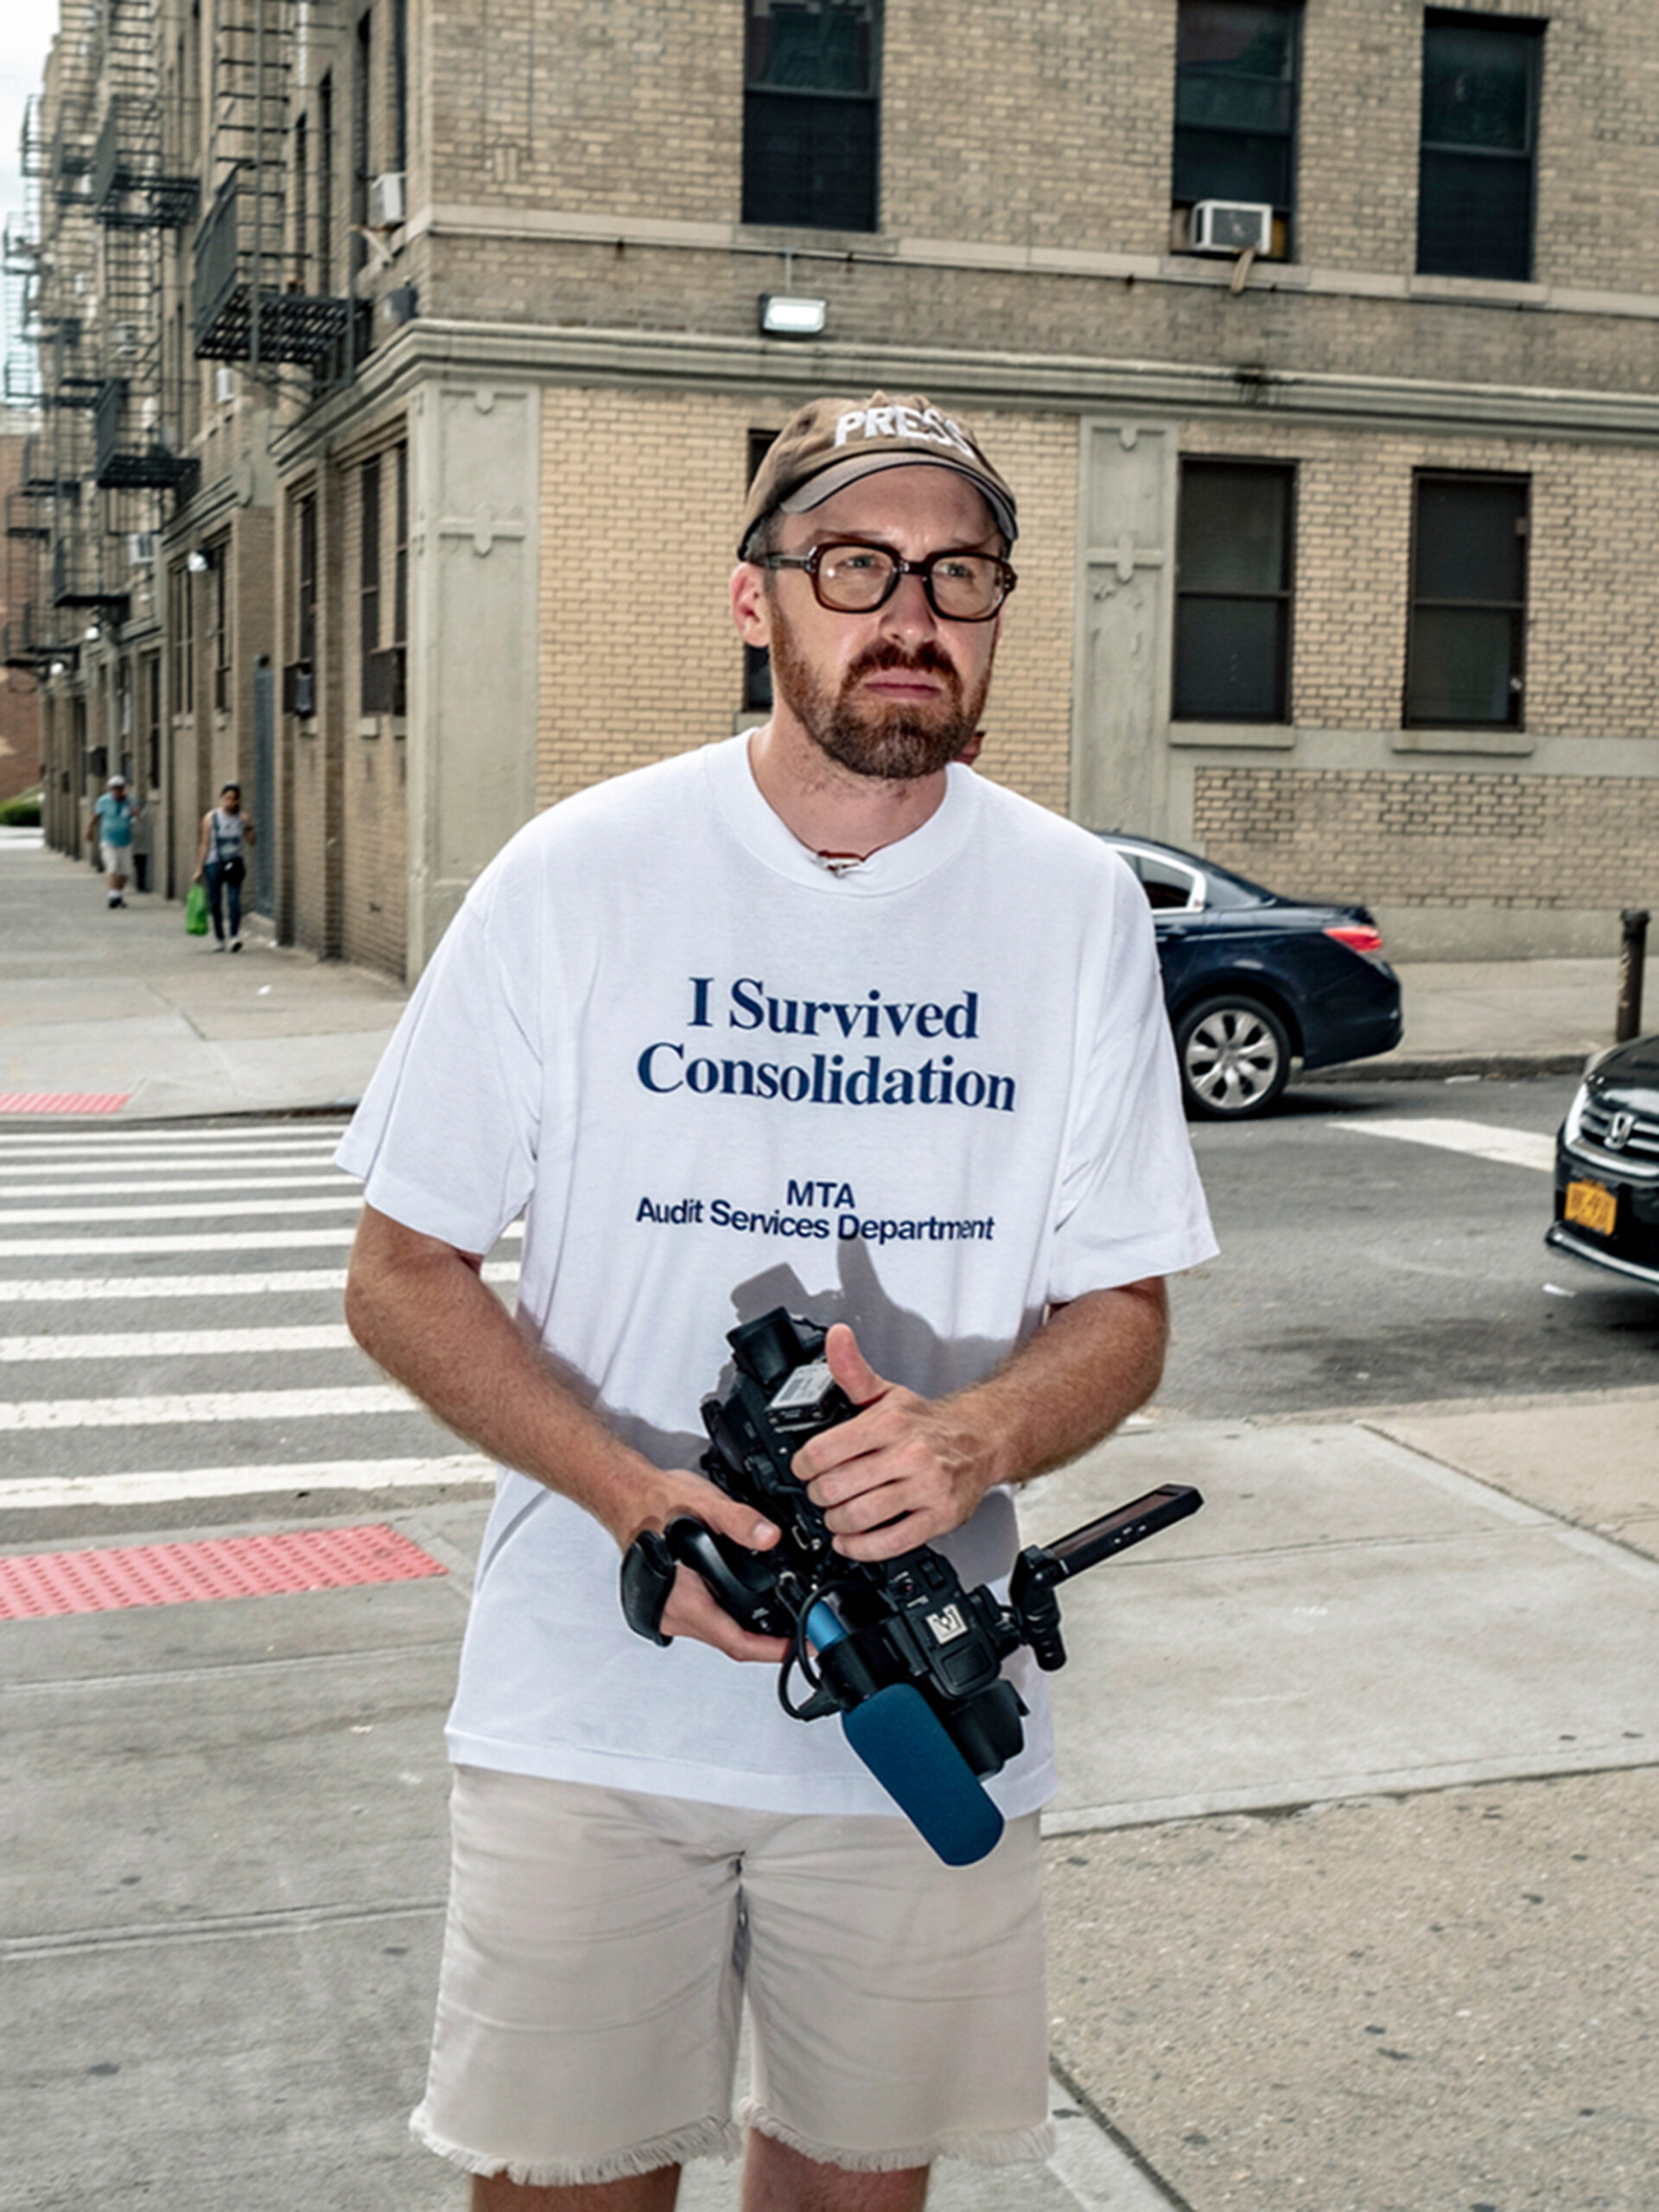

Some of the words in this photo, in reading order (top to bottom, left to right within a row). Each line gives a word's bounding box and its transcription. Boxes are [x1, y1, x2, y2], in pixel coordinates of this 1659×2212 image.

[689, 977, 714, 1027] I
[729, 978, 979, 1039] Survived
[637, 1042, 1016, 1112] Consolidation
[636, 1197, 704, 1224] Audit
[710, 1199, 830, 1239] Services
[837, 1214, 995, 1245] Department
[787, 1179, 855, 1209] MTA
